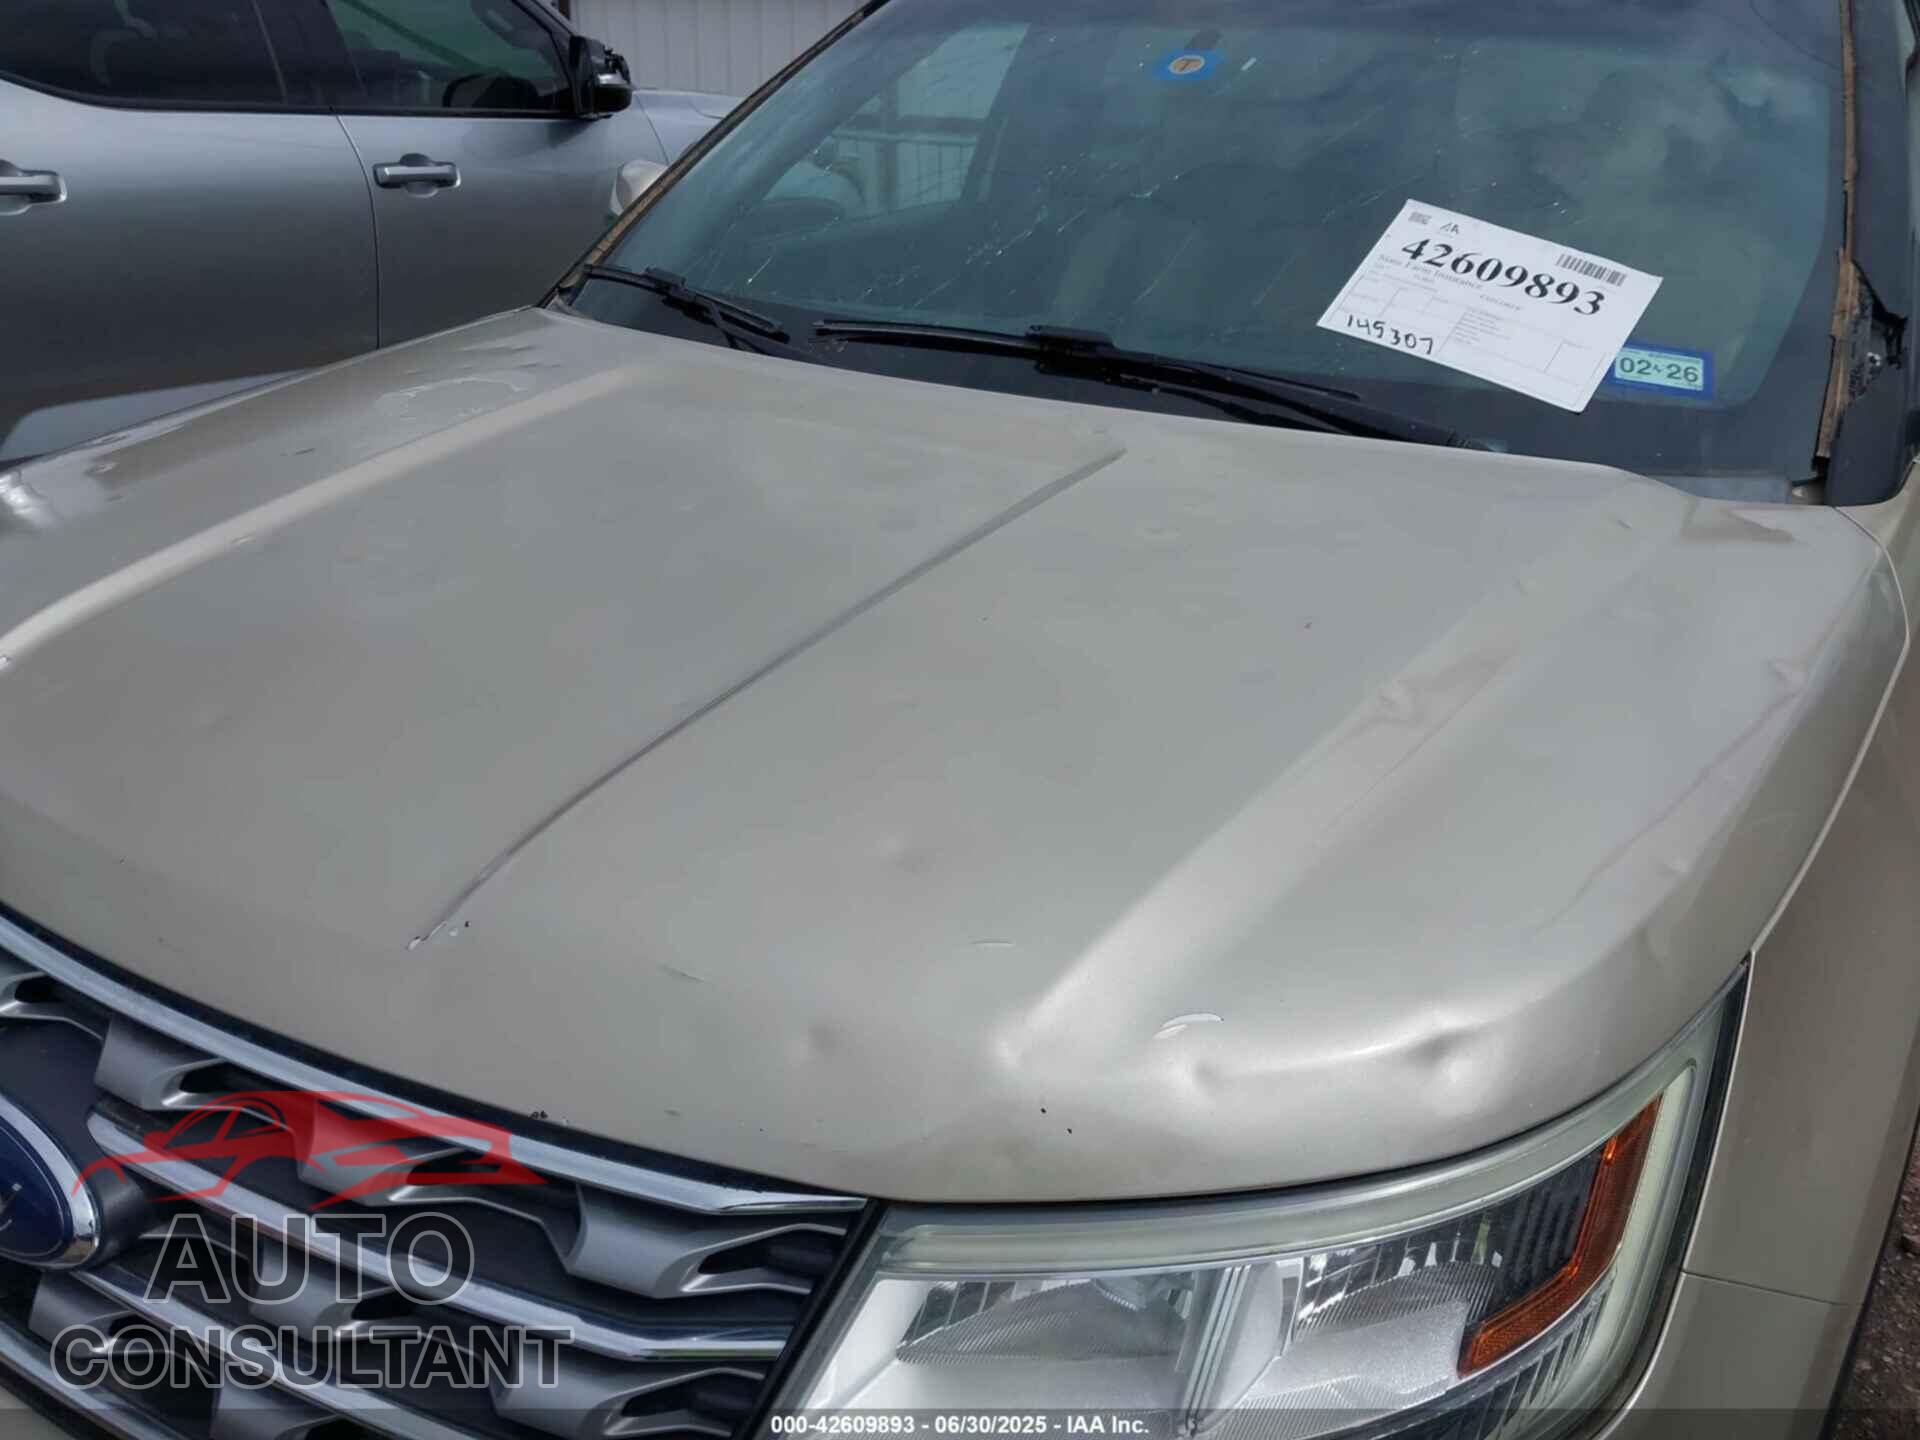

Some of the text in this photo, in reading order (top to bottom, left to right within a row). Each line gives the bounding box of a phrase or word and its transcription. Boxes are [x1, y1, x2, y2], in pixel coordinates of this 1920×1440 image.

[1401, 238, 1606, 315] 42609893
[1619, 357, 1699, 383] 02 26
